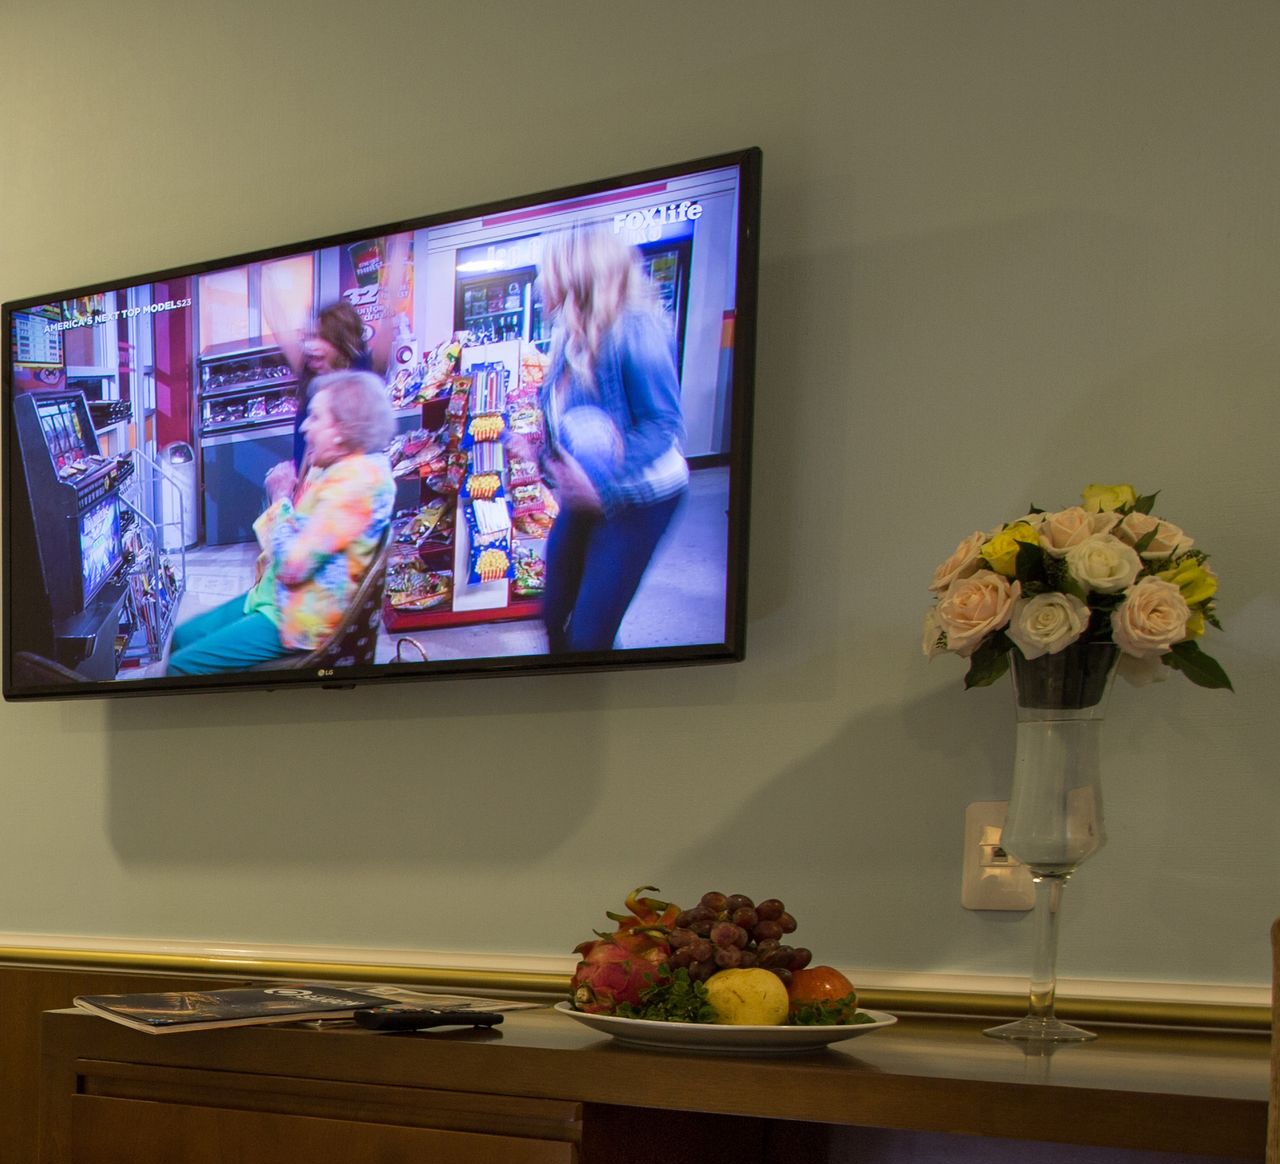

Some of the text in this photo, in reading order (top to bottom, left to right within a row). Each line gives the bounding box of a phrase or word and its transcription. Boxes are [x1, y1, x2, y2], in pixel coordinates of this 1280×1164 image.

[43, 314, 93, 334] AMERICA'S
[94, 310, 120, 327] NEXT
[120, 306, 142, 319] TOP
